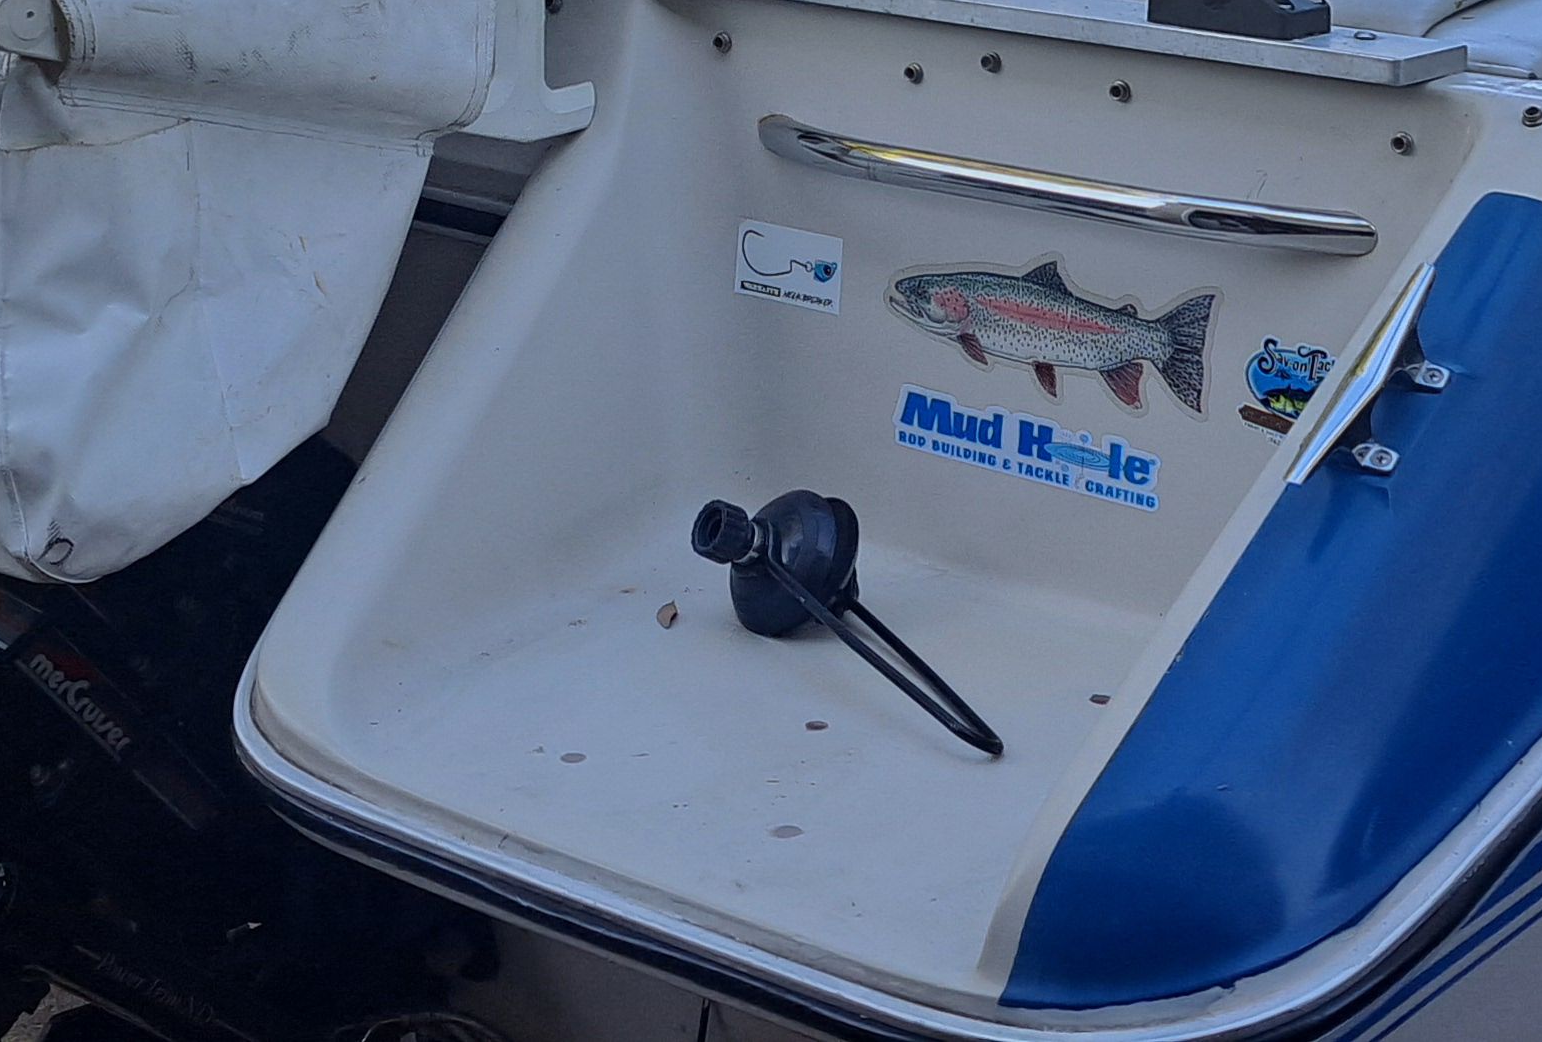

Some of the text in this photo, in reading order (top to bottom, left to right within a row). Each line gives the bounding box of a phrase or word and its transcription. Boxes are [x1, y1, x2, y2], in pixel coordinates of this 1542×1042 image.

[900, 391, 1003, 449] Mud
[898, 430, 1156, 509] ROD BUILDING & TACKLE CRAFTING
